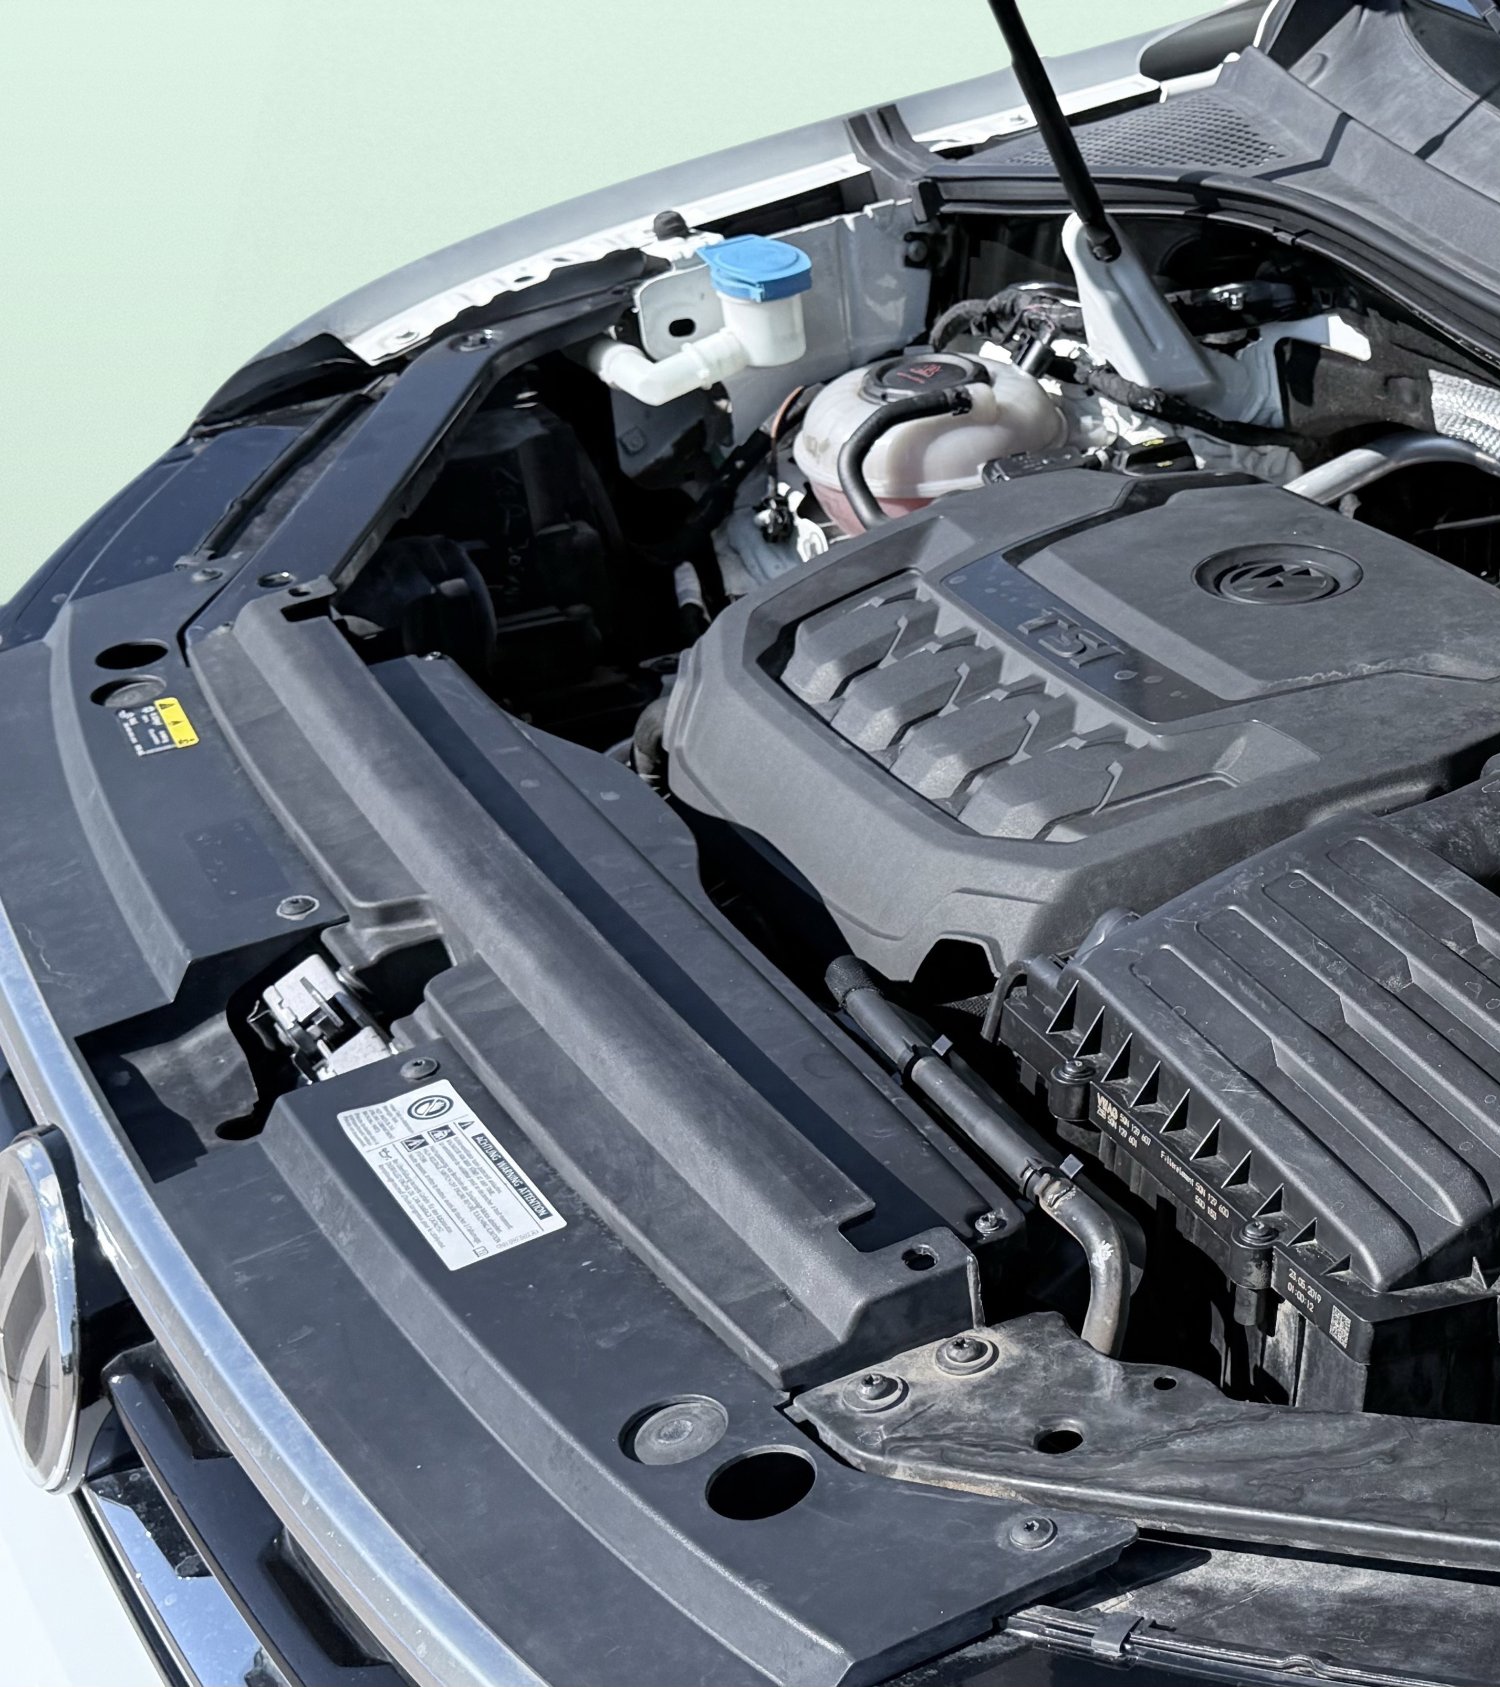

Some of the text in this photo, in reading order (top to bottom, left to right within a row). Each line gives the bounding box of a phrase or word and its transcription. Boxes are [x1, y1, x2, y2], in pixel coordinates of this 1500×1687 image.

[1016, 606, 1125, 669] TSI
[475, 1136, 550, 1217] ACHTUNG WARNING ATTENTION
